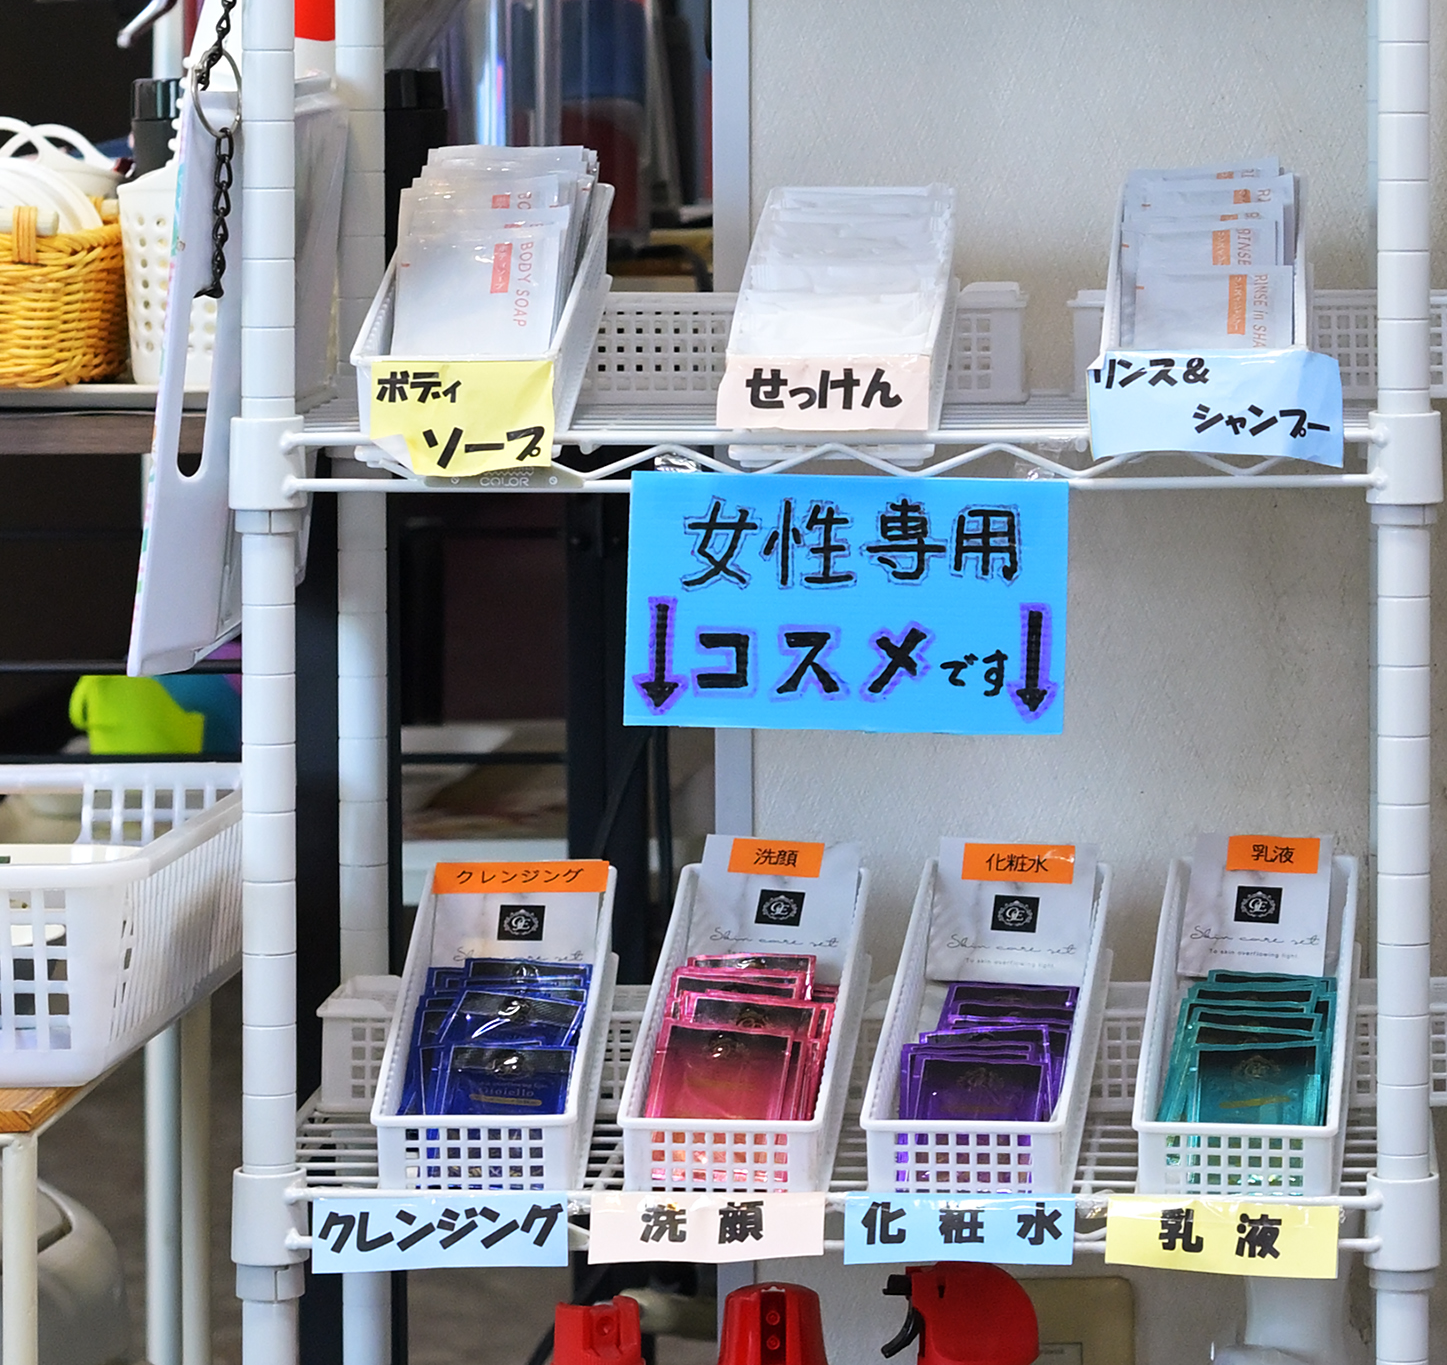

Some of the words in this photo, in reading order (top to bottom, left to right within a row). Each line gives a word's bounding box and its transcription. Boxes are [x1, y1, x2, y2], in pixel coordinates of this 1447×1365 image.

[517, 241, 535, 284] BODY
[1253, 273, 1269, 307] RINSE
[512, 289, 531, 327] SOAP
[375, 370, 461, 404] ボディ
[745, 367, 903, 411] せっけん
[1192, 404, 1331, 438] シャンプー
[422, 426, 546, 469] ソープ
[479, 476, 530, 488] COLOR
[681, 494, 1023, 593] 女性専用
[691, 621, 1010, 703] コスメです
[753, 847, 800, 868] 洗顔
[985, 852, 1049, 874] 化粧水
[1251, 843, 1296, 865] 乳液
[456, 867, 585, 885] クレンジング
[317, 1203, 563, 1254] クレンジング
